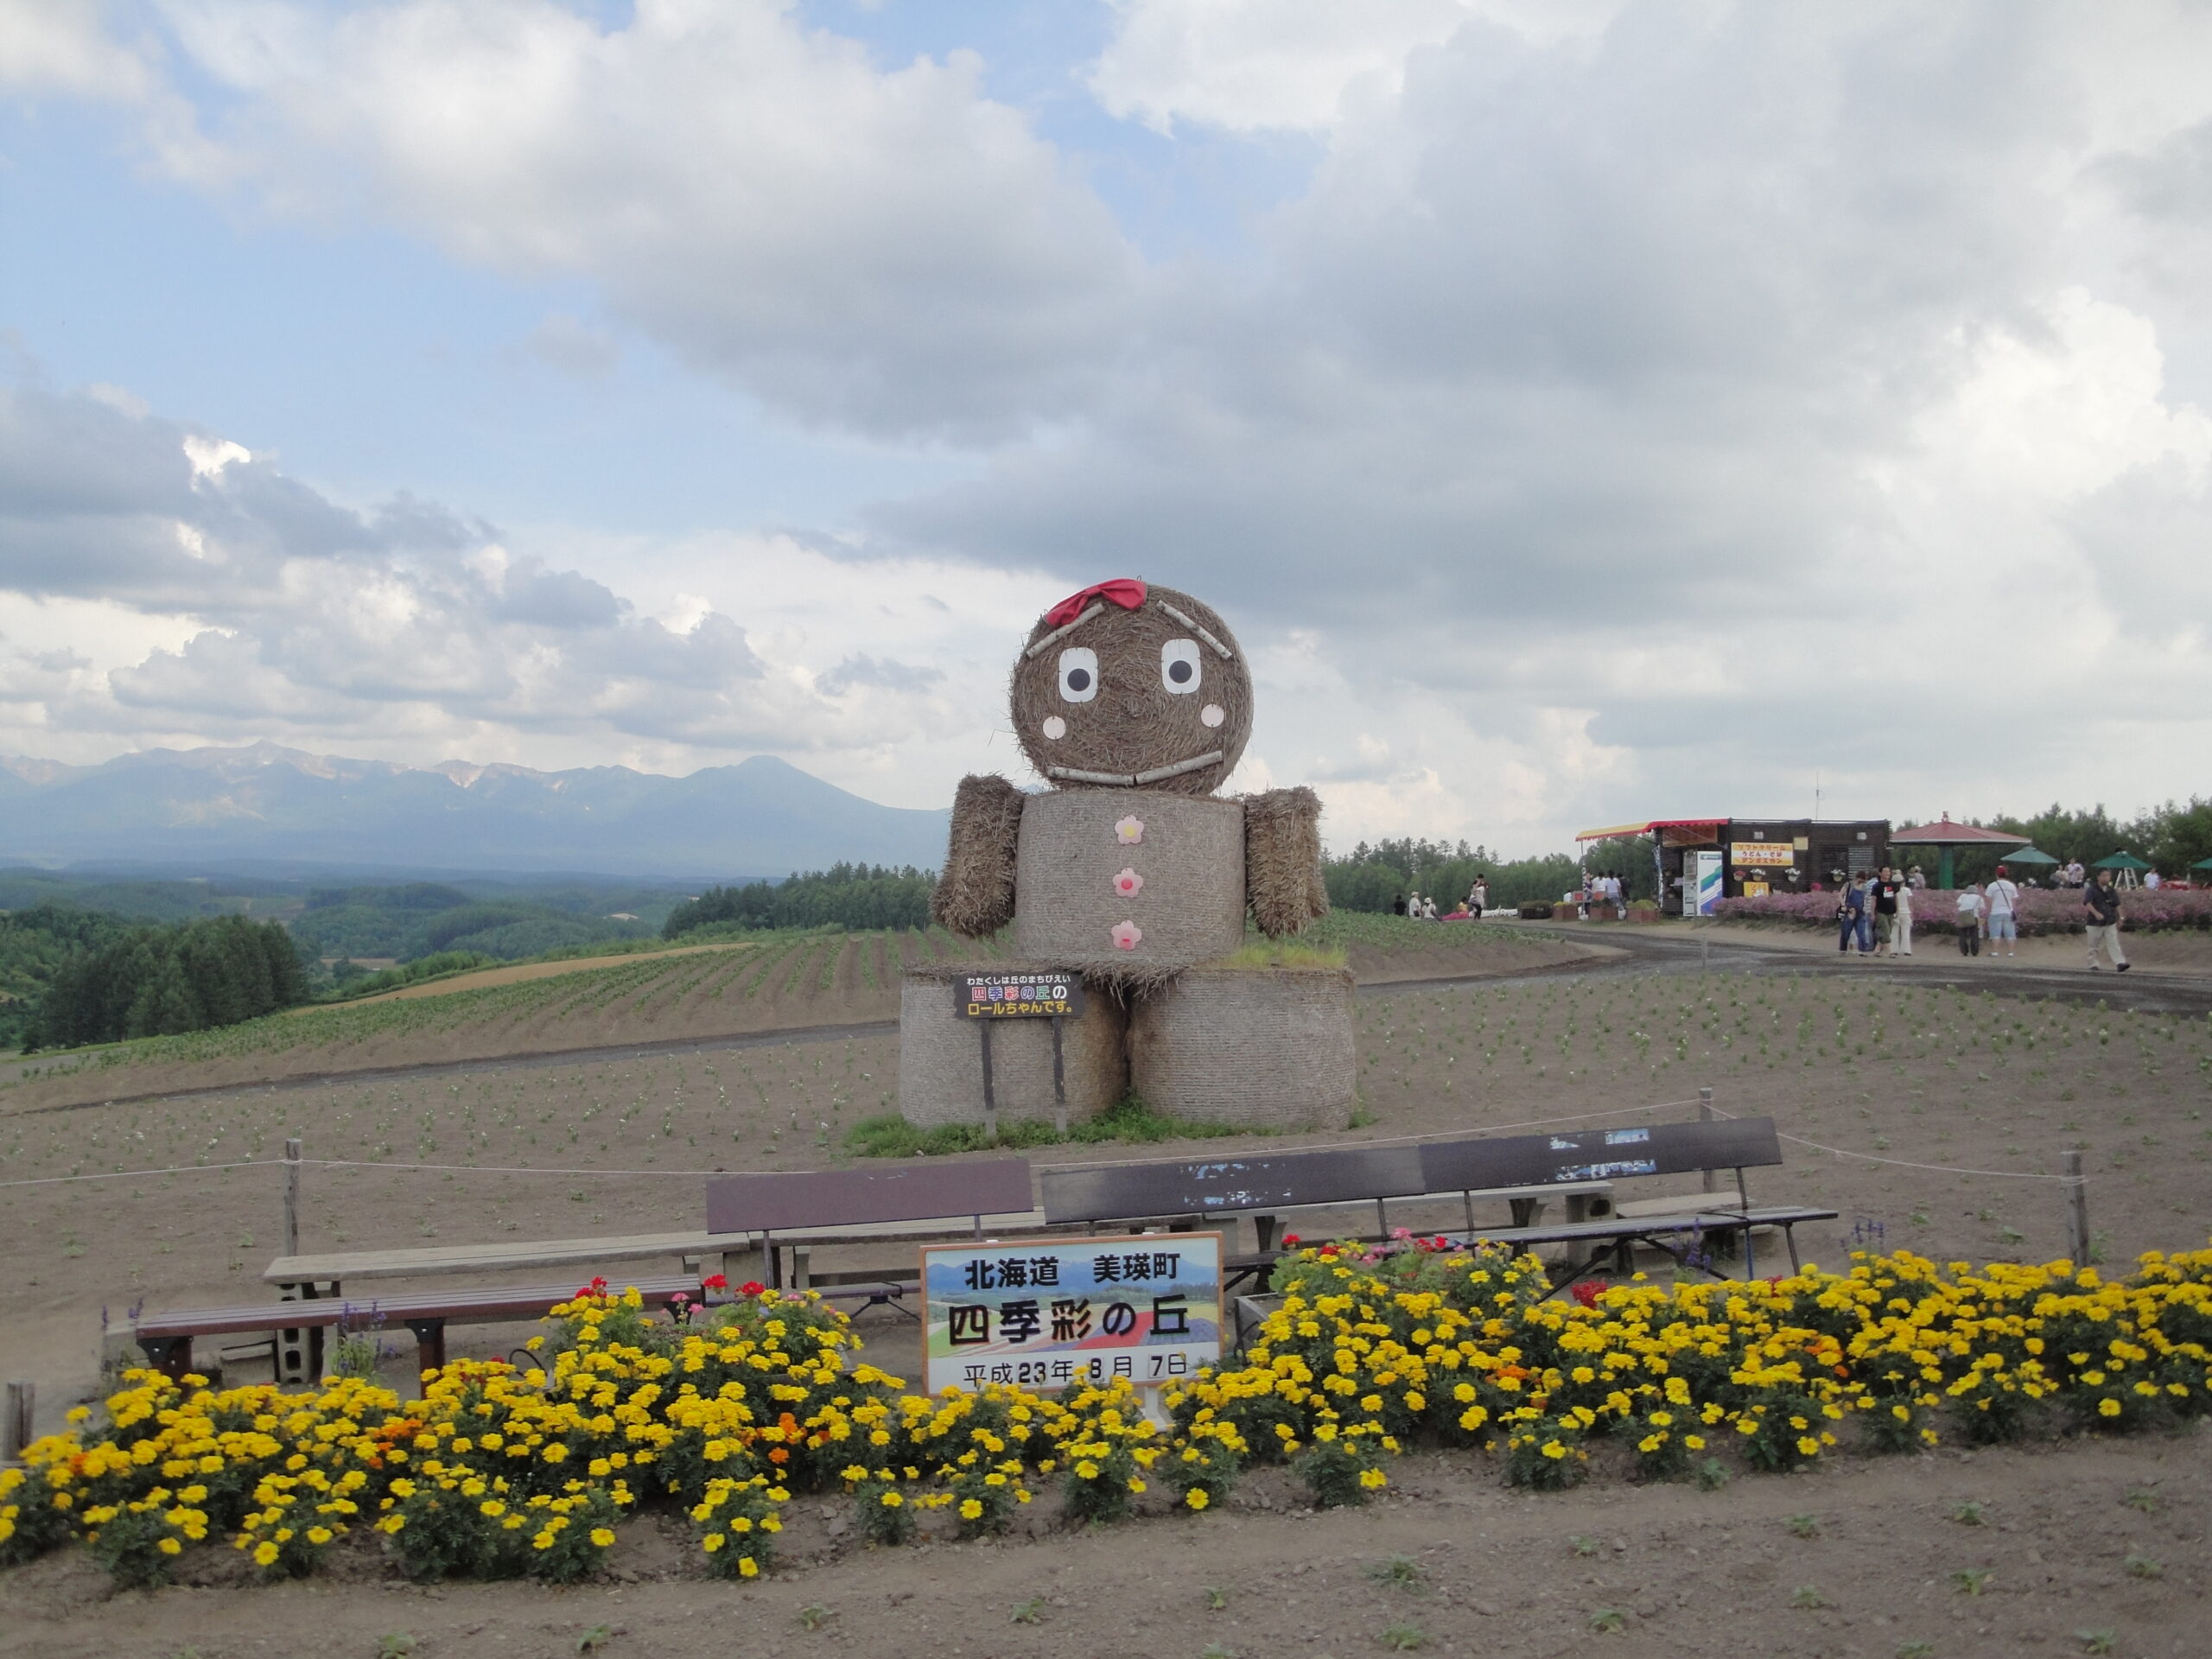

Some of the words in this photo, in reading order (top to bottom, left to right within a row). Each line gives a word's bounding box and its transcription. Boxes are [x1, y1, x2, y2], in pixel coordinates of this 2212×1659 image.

[966, 975, 1071, 986] わたくしは丘のまちびえい
[971, 985, 1067, 1001] 四季彩の丘の
[968, 1000, 1072, 1015] ロールちゃんです。
[964, 1256, 1059, 1290] 北海道
[1093, 1252, 1180, 1283] 美瑛町
[949, 1294, 1190, 1345] 四季彩の丘
